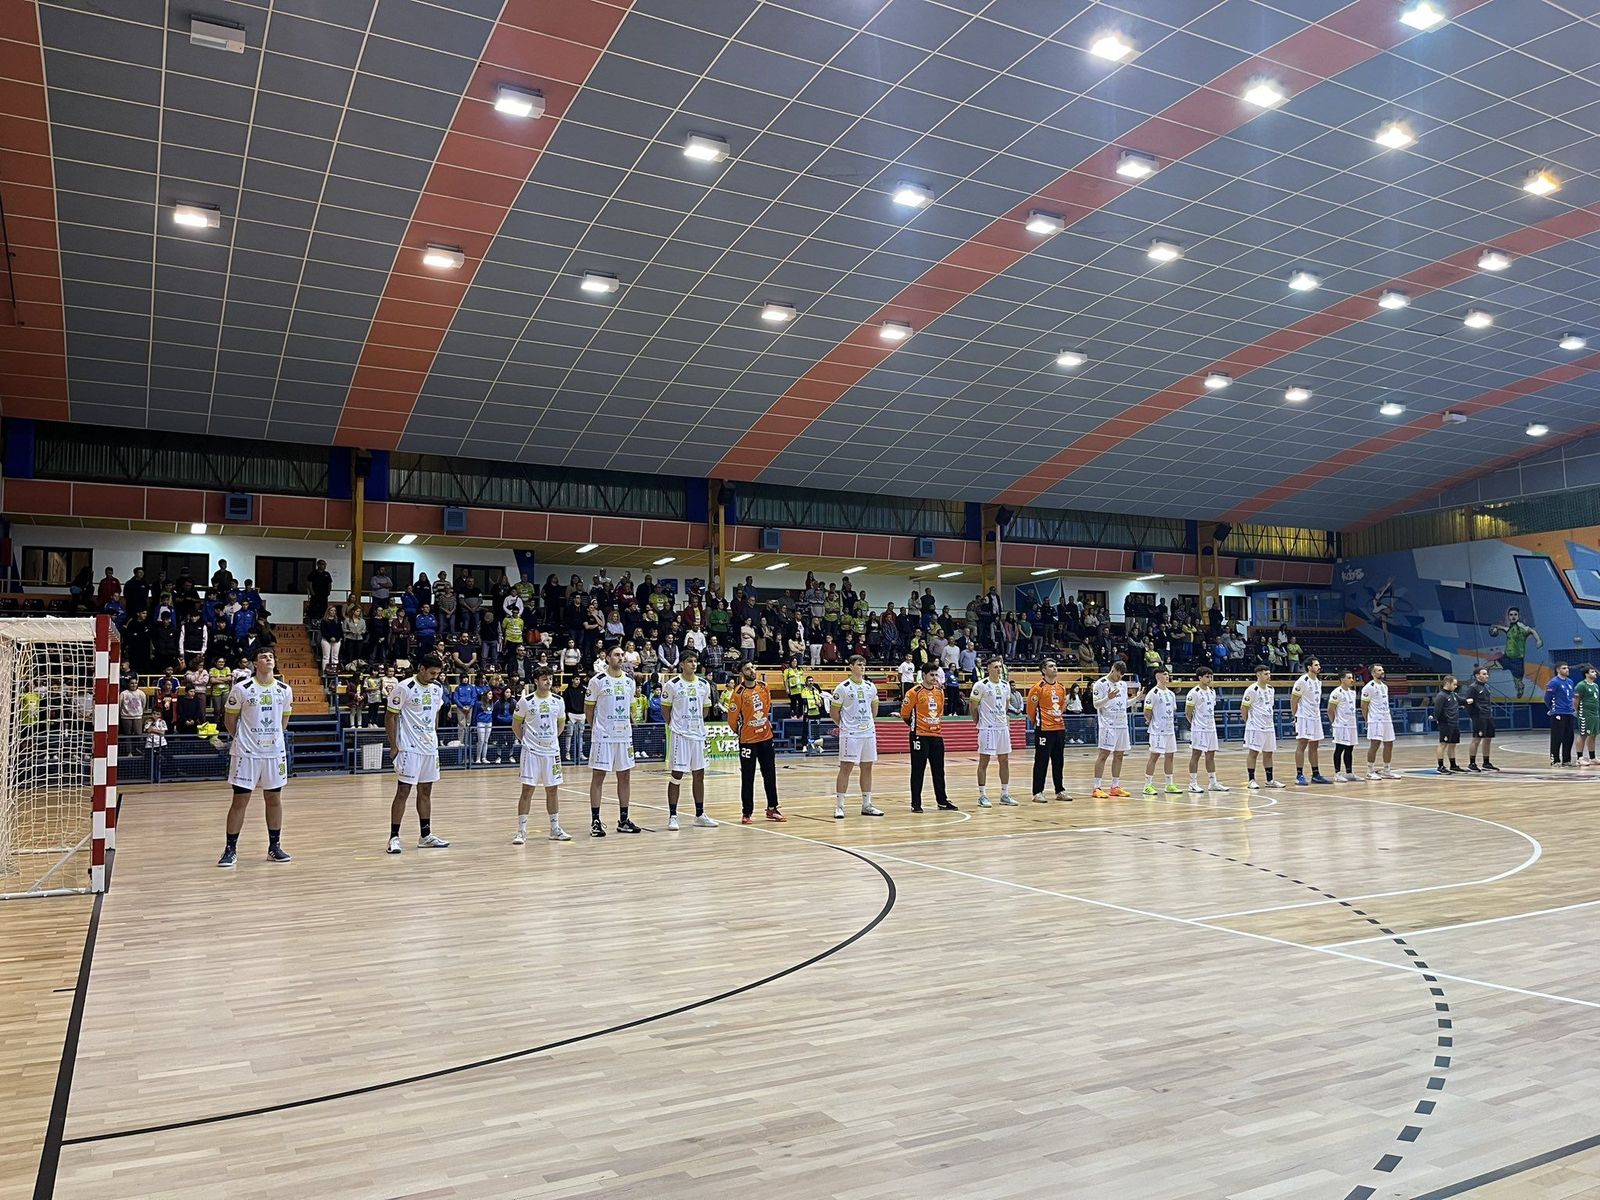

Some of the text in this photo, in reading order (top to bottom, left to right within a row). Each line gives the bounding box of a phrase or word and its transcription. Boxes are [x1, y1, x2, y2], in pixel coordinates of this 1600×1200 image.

[913, 740, 921, 750] 16
[1039, 737, 1047, 746] 12
[741, 747, 752, 758] 22
